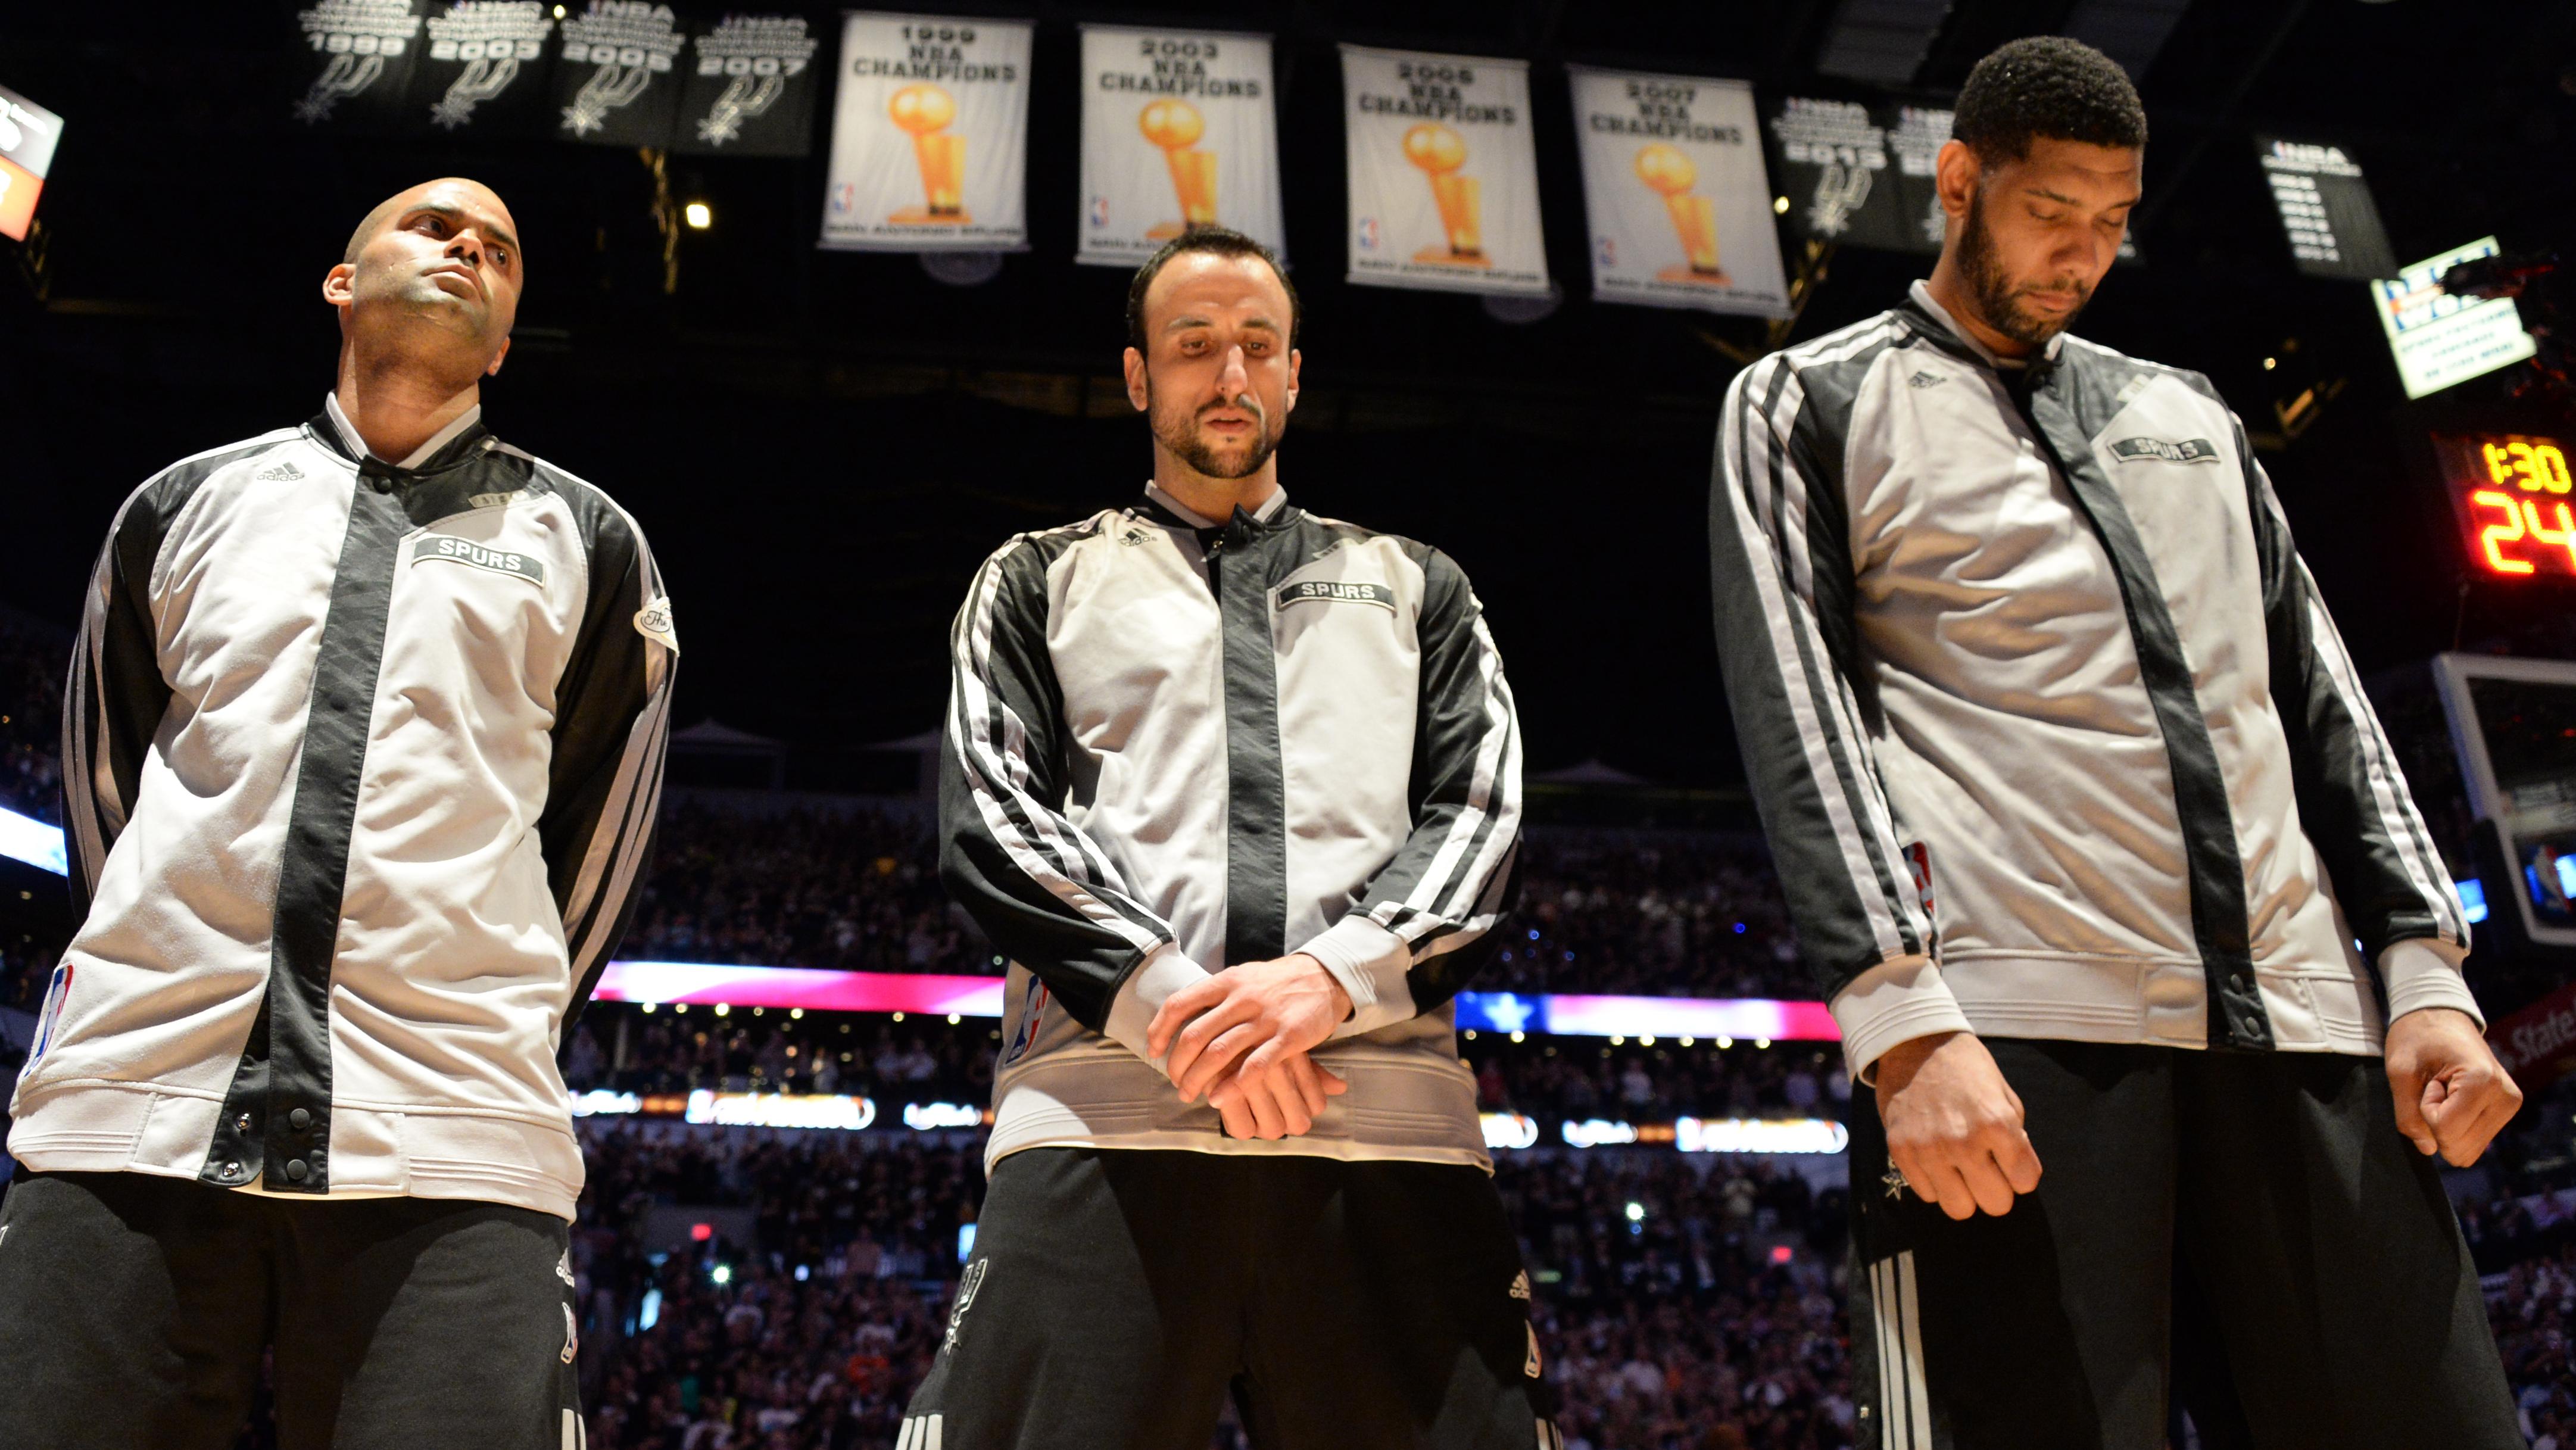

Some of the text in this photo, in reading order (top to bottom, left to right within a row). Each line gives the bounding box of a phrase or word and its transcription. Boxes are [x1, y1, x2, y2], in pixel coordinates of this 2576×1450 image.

[307, 32, 406, 57] 1999
[902, 26, 976, 43] 1999
[430, 39, 541, 60] 2003
[909, 44, 963, 61] NBA
[1140, 39, 1218, 58] 2003
[697, 57, 807, 76] 2007
[853, 57, 1016, 82] CHAMPIONS
[1153, 59, 1206, 76] NBA
[1099, 71, 1262, 99] CHAMPIONS
[1409, 85, 1462, 101] NBA
[1358, 92, 1517, 126] CHAMPIONS
[1639, 102, 1691, 120] NBA
[1590, 113, 1744, 145] CHAMPIONS
[2135, 438, 2198, 460] SPURS
[257, 472, 305, 482] adidas
[2483, 442, 2572, 494] 1:30
[2473, 491, 2576, 574] 24
[438, 539, 522, 571] SPURS
[1301, 582, 1376, 600] SPURS
[2511, 1010, 2575, 1067] State
